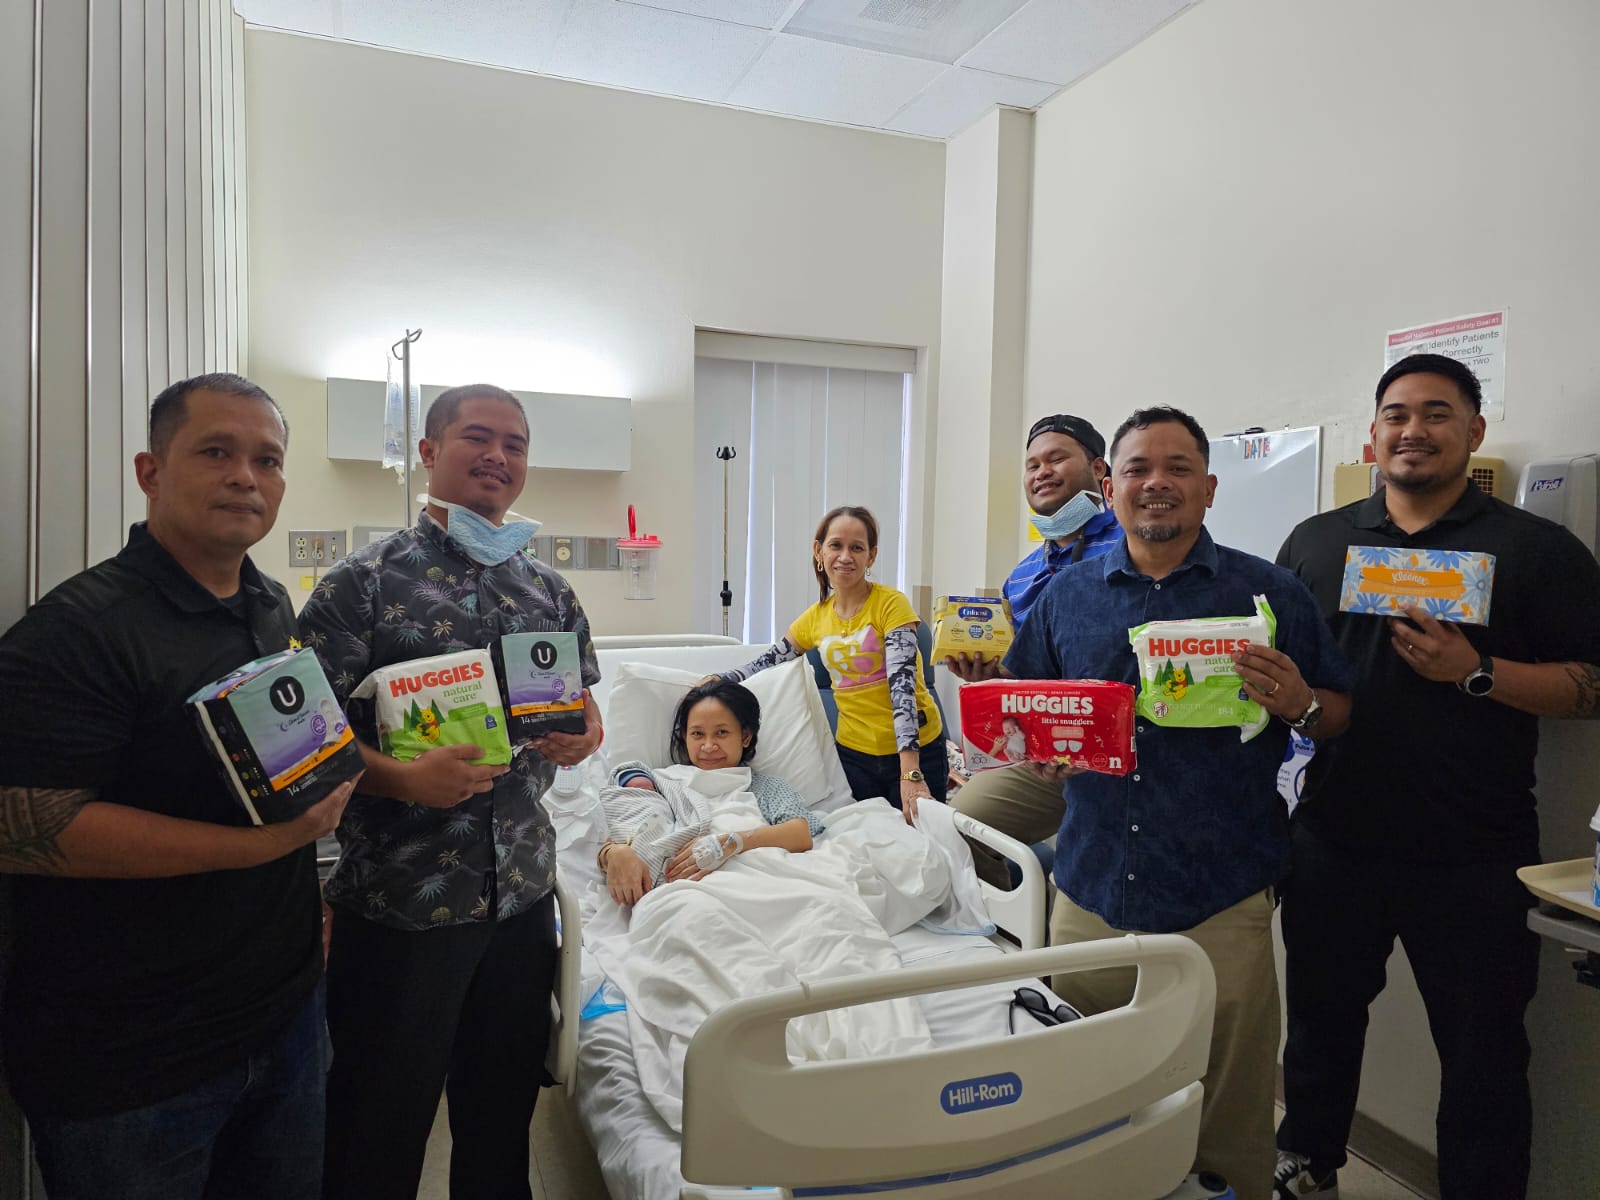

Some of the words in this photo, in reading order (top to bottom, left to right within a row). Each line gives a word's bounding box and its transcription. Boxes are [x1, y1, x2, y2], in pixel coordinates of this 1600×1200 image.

[1429, 336, 1460, 348] Identify
[1462, 331, 1499, 343] Patients
[1442, 345, 1483, 357] Correctly
[1473, 357, 1490, 365] TWO
[1244, 437, 1270, 459] DATE
[537, 647, 551, 664] U
[1148, 638, 1250, 656] HUGGIES
[389, 661, 485, 698] HUGGIES
[277, 683, 297, 707] U
[443, 681, 482, 698] natural
[453, 693, 477, 704] care
[1001, 694, 1094, 714] HUGGIES
[521, 715, 531, 724] 14
[1041, 716, 1059, 725] little
[1060, 717, 1094, 726] snugglers
[1109, 756, 1122, 769] n
[286, 784, 300, 796] 14
[948, 1082, 1015, 1107] Hill-Rom
